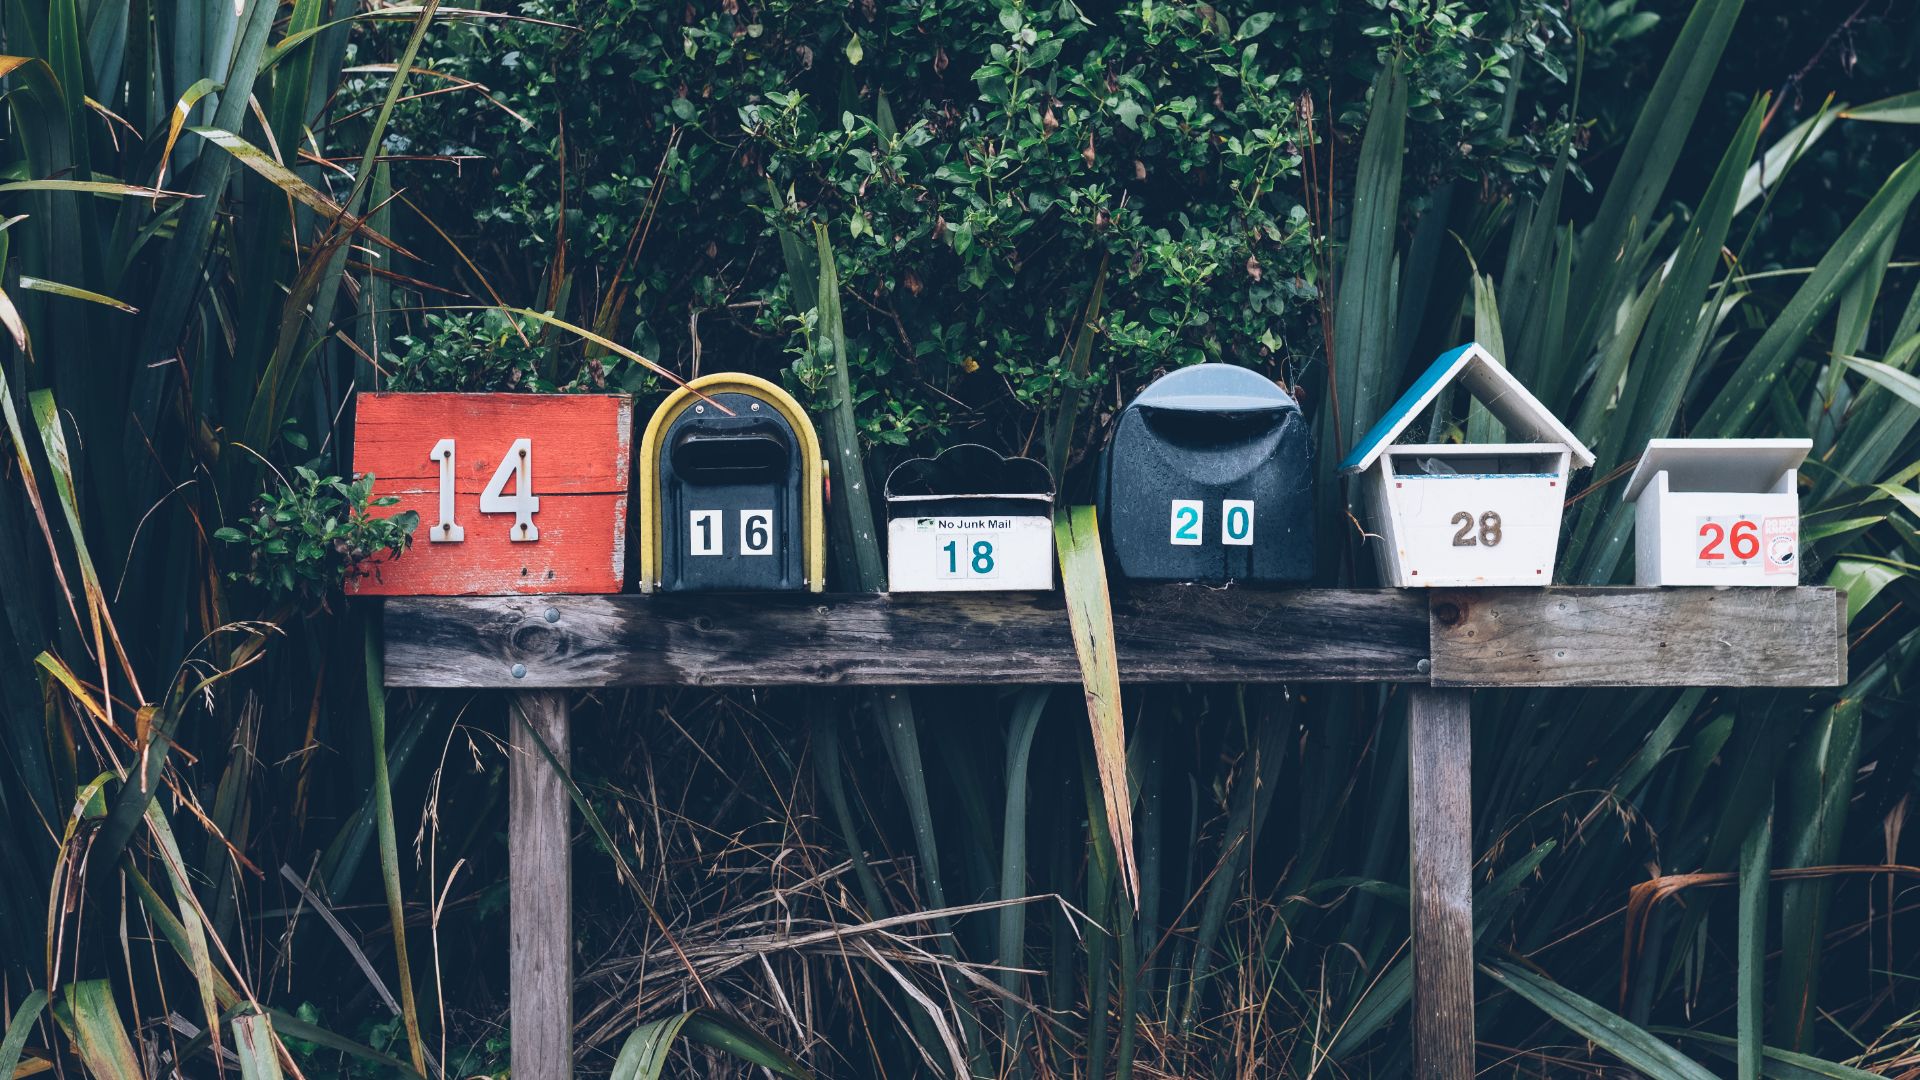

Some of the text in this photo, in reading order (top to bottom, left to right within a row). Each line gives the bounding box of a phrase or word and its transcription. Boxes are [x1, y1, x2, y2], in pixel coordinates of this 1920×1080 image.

[430, 438, 540, 543] 14
[696, 515, 769, 551] 16
[938, 519, 1011, 529] No Junk Mail
[1175, 506, 1249, 540] 20
[1451, 510, 1502, 547] 28
[1698, 520, 1760, 560] 26
[943, 540, 995, 574] 18
